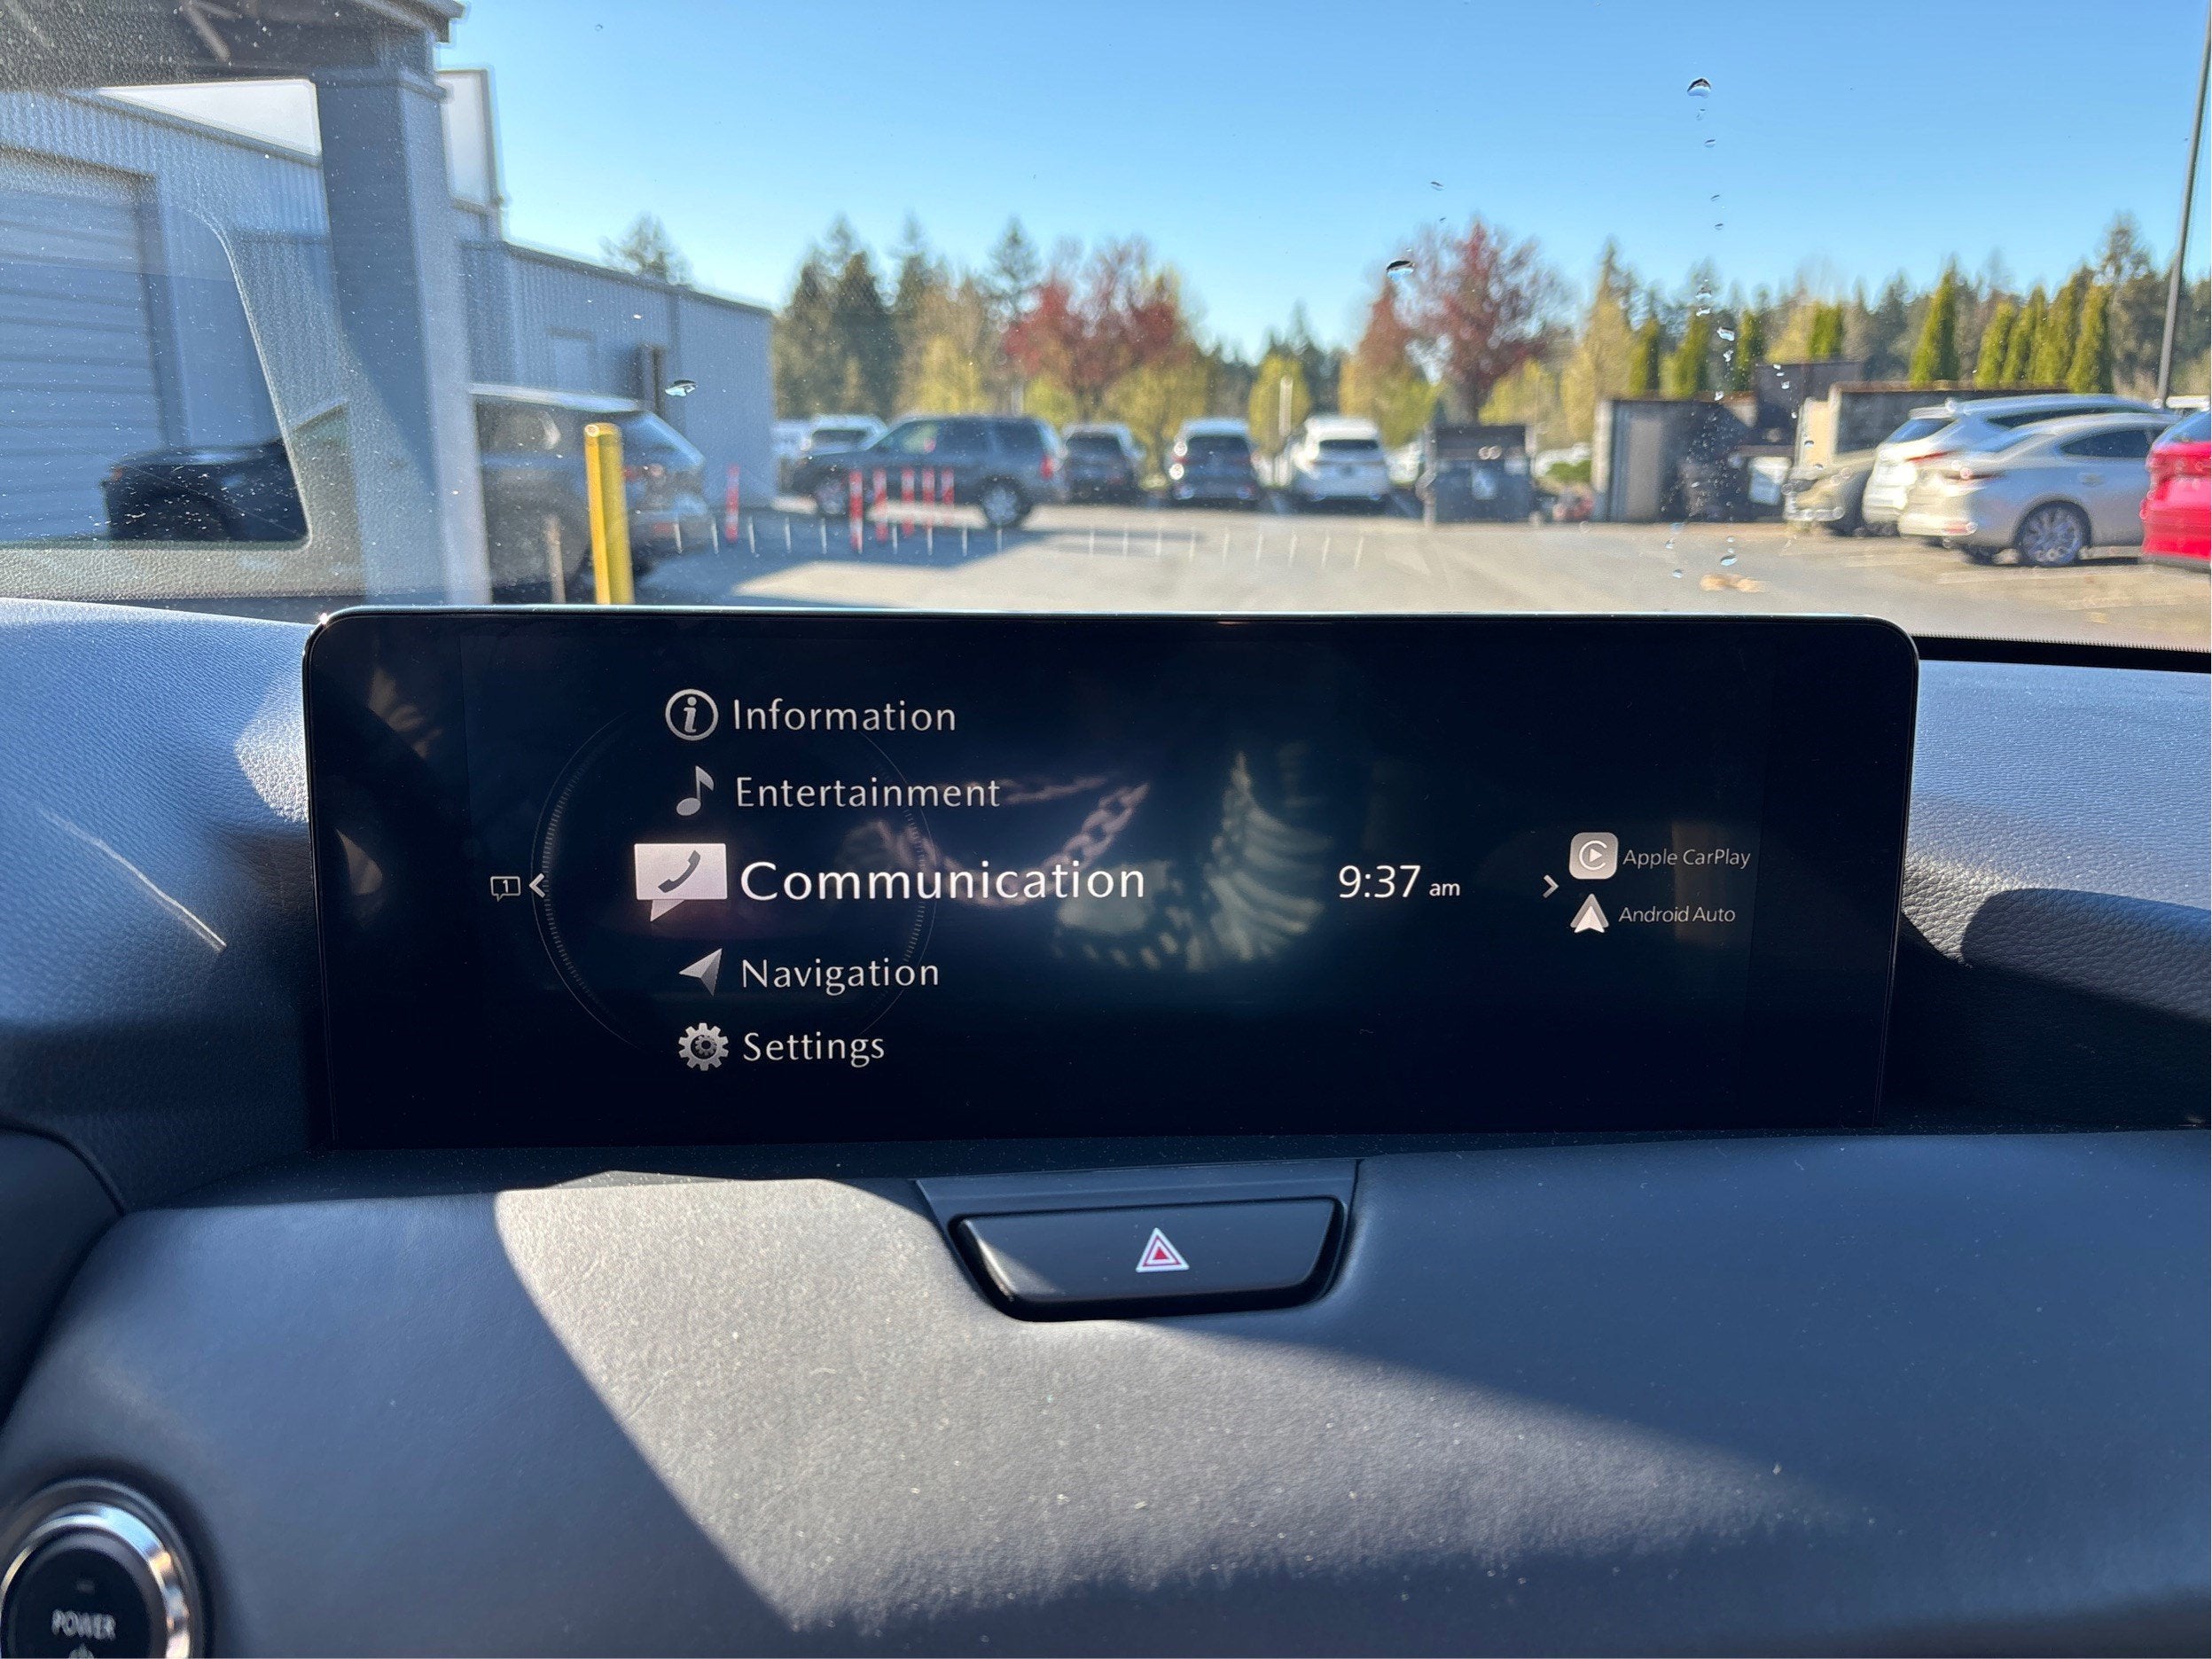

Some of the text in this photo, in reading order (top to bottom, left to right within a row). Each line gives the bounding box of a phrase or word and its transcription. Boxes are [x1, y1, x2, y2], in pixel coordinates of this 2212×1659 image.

[734, 698, 955, 731] Information
[737, 776, 1001, 808] Entertainment
[1622, 848, 1751, 870] Apple CarPlay
[502, 879, 510, 893] 1
[740, 860, 1145, 901] Communication
[1339, 865, 1461, 898] 9:37 am
[1618, 905, 1736, 923] Android Auto
[742, 957, 938, 996] Navigation
[743, 1031, 885, 1068] Settings
[51, 1609, 116, 1640] POWER
